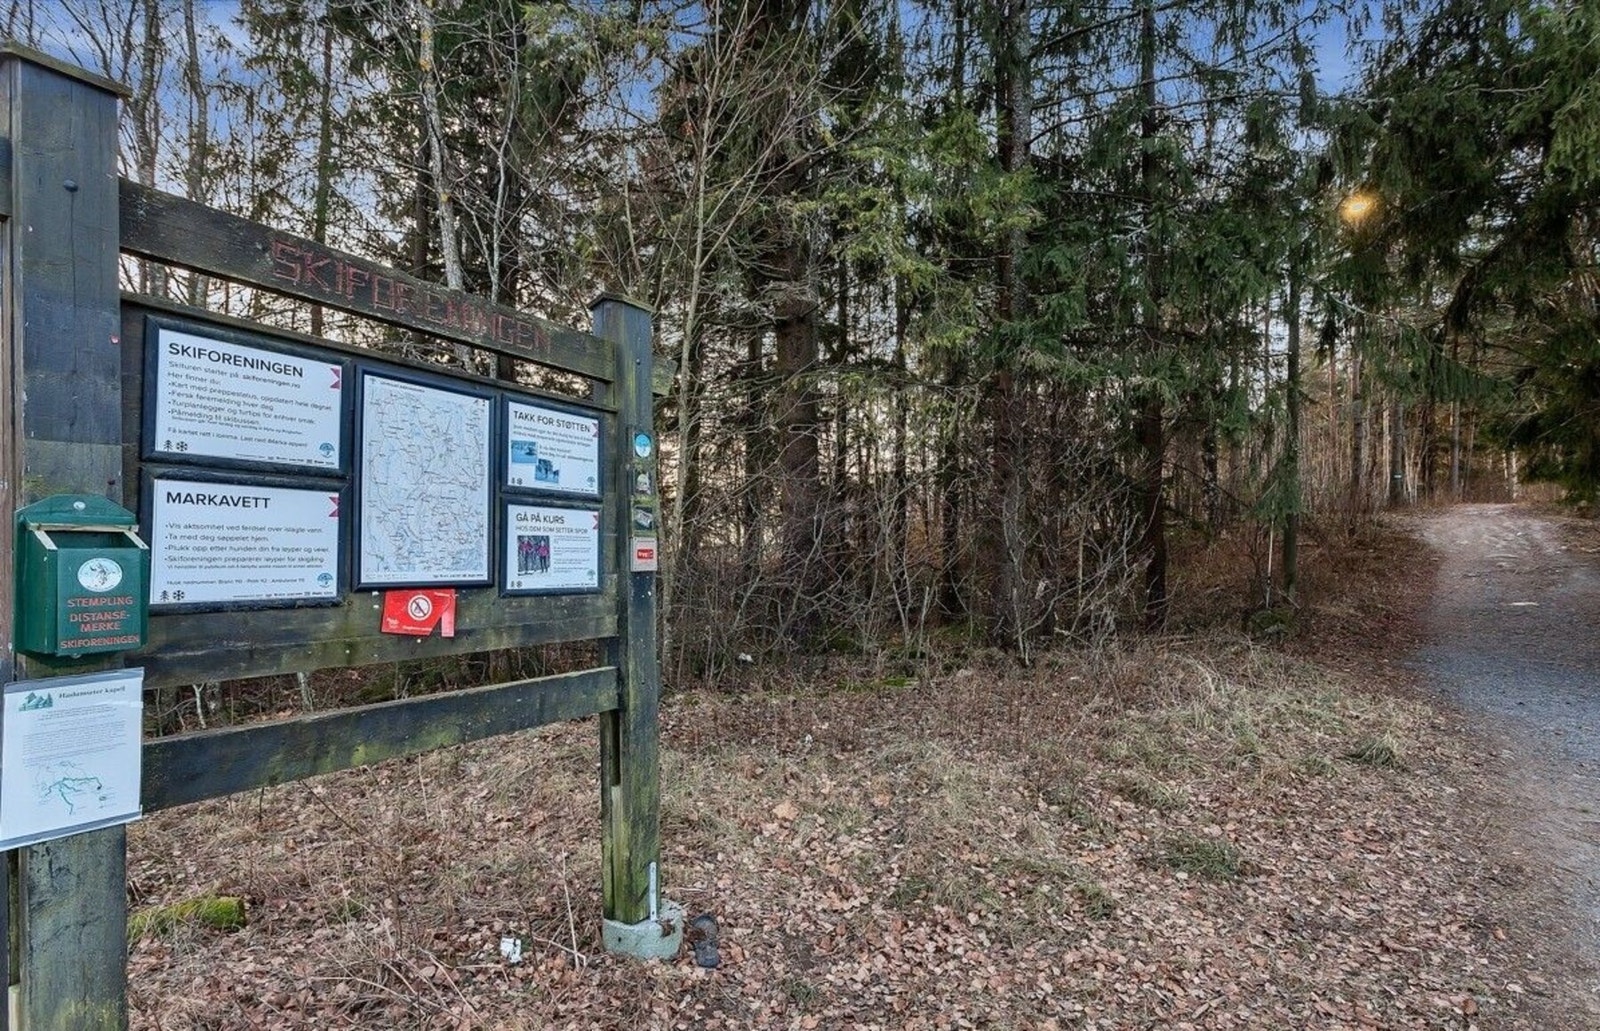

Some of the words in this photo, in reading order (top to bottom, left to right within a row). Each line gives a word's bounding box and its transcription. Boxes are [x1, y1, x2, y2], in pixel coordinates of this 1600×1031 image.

[271, 239, 550, 350] SKIFORENINGEN
[168, 341, 303, 378] SKIFORENINGEN
[513, 410, 535, 422] TAKK
[537, 414, 554, 426] FOR
[556, 418, 589, 432] STØTTEN
[165, 491, 271, 509] MARKAVETT
[515, 511, 528, 522] GÅ
[530, 512, 541, 522] PÅ
[542, 514, 564, 524] KURS
[67, 596, 133, 608] STEMPLING
[70, 610, 131, 622] DISTANSE-
[80, 621, 121, 632] MERKE
[60, 635, 140, 649] SKIFORENINGEN
